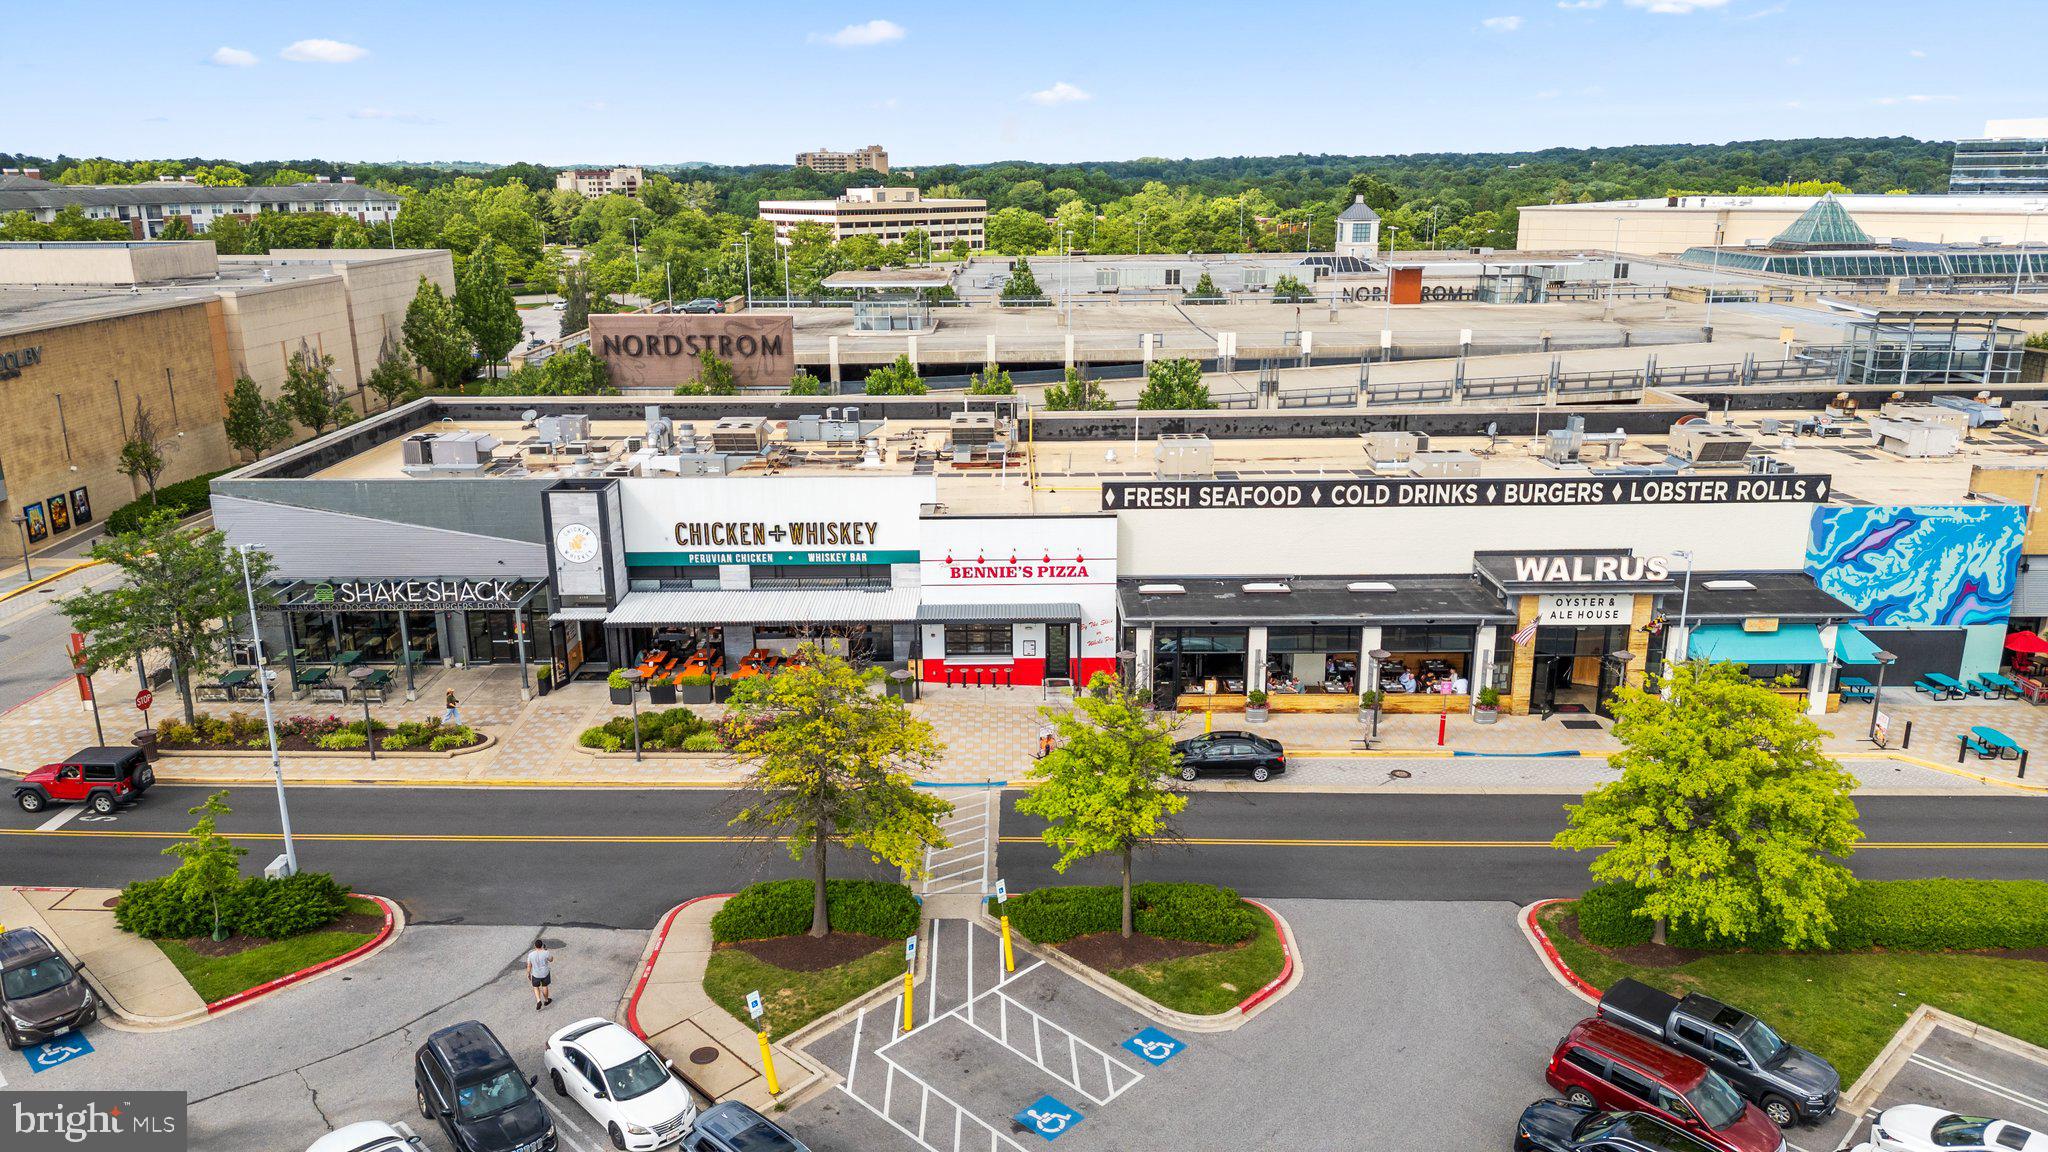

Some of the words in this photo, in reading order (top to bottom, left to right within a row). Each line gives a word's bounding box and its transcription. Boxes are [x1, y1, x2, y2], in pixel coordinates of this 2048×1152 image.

[1343, 286, 1463, 302] NORROM
[602, 334, 783, 357] NORDSTROM
[1123, 487, 1190, 507] FRESH
[1199, 485, 1301, 507] SEAFOOD
[1331, 484, 1390, 505] COLD
[1399, 483, 1478, 504] DRINKS
[1504, 482, 1604, 503] BURGERS
[1630, 481, 1728, 502] LOBSTER
[1736, 480, 1807, 501] ROLLS
[689, 554, 733, 563] PERUVIAN
[735, 553, 774, 563] CHICKEN
[808, 552, 847, 562] WHISKEY
[850, 552, 868, 562] BAR
[950, 566, 1034, 579] BENNIE'S
[1037, 565, 1090, 578] PIZZA
[1514, 556, 1670, 582] WALRUS
[341, 582, 422, 602] SHAKE
[427, 581, 511, 601] SHACK
[433, 602, 473, 610] BURGERS
[1556, 598, 1605, 607] OYSTER
[1608, 597, 1616, 606] &
[1550, 610, 1573, 619] ALE
[1578, 610, 1619, 619] HOUSE
[136, 693, 152, 707] STOP
